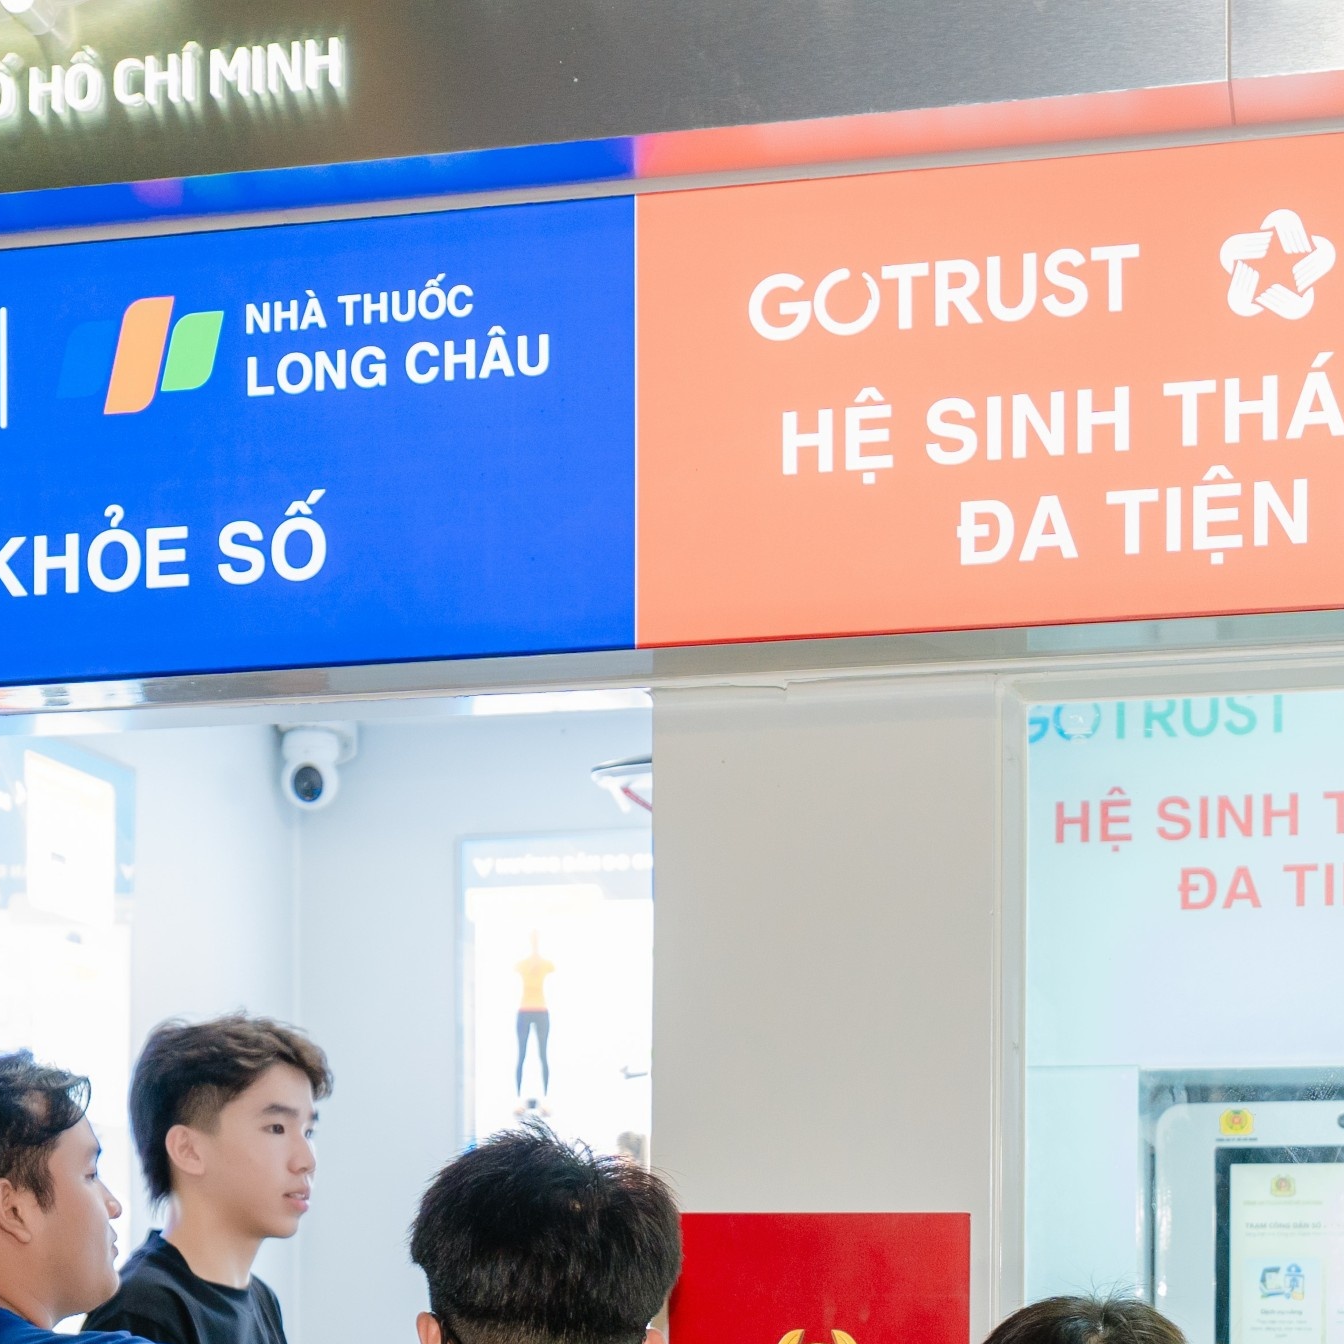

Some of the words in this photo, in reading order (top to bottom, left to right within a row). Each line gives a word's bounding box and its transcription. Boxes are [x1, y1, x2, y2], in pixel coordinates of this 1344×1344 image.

[29, 46, 102, 115] HỒ
[113, 42, 204, 106] CHÍ
[210, 38, 343, 97] MINH
[245, 290, 325, 333] NHÀ
[337, 274, 474, 326] THUỐC
[748, 243, 1140, 341] GOTRUST
[247, 345, 387, 397] LONG
[406, 324, 551, 383] CHÂU
[782, 388, 894, 485] HỆ
[925, 385, 1132, 464] SINH
[218, 489, 328, 584] SỐ
[956, 495, 1078, 565] ĐA
[1106, 465, 1309, 564] TIỆN
[1055, 787, 1133, 851] HỆ
[1157, 793, 1299, 842] SINH
[1178, 866, 1262, 911] ĐA
